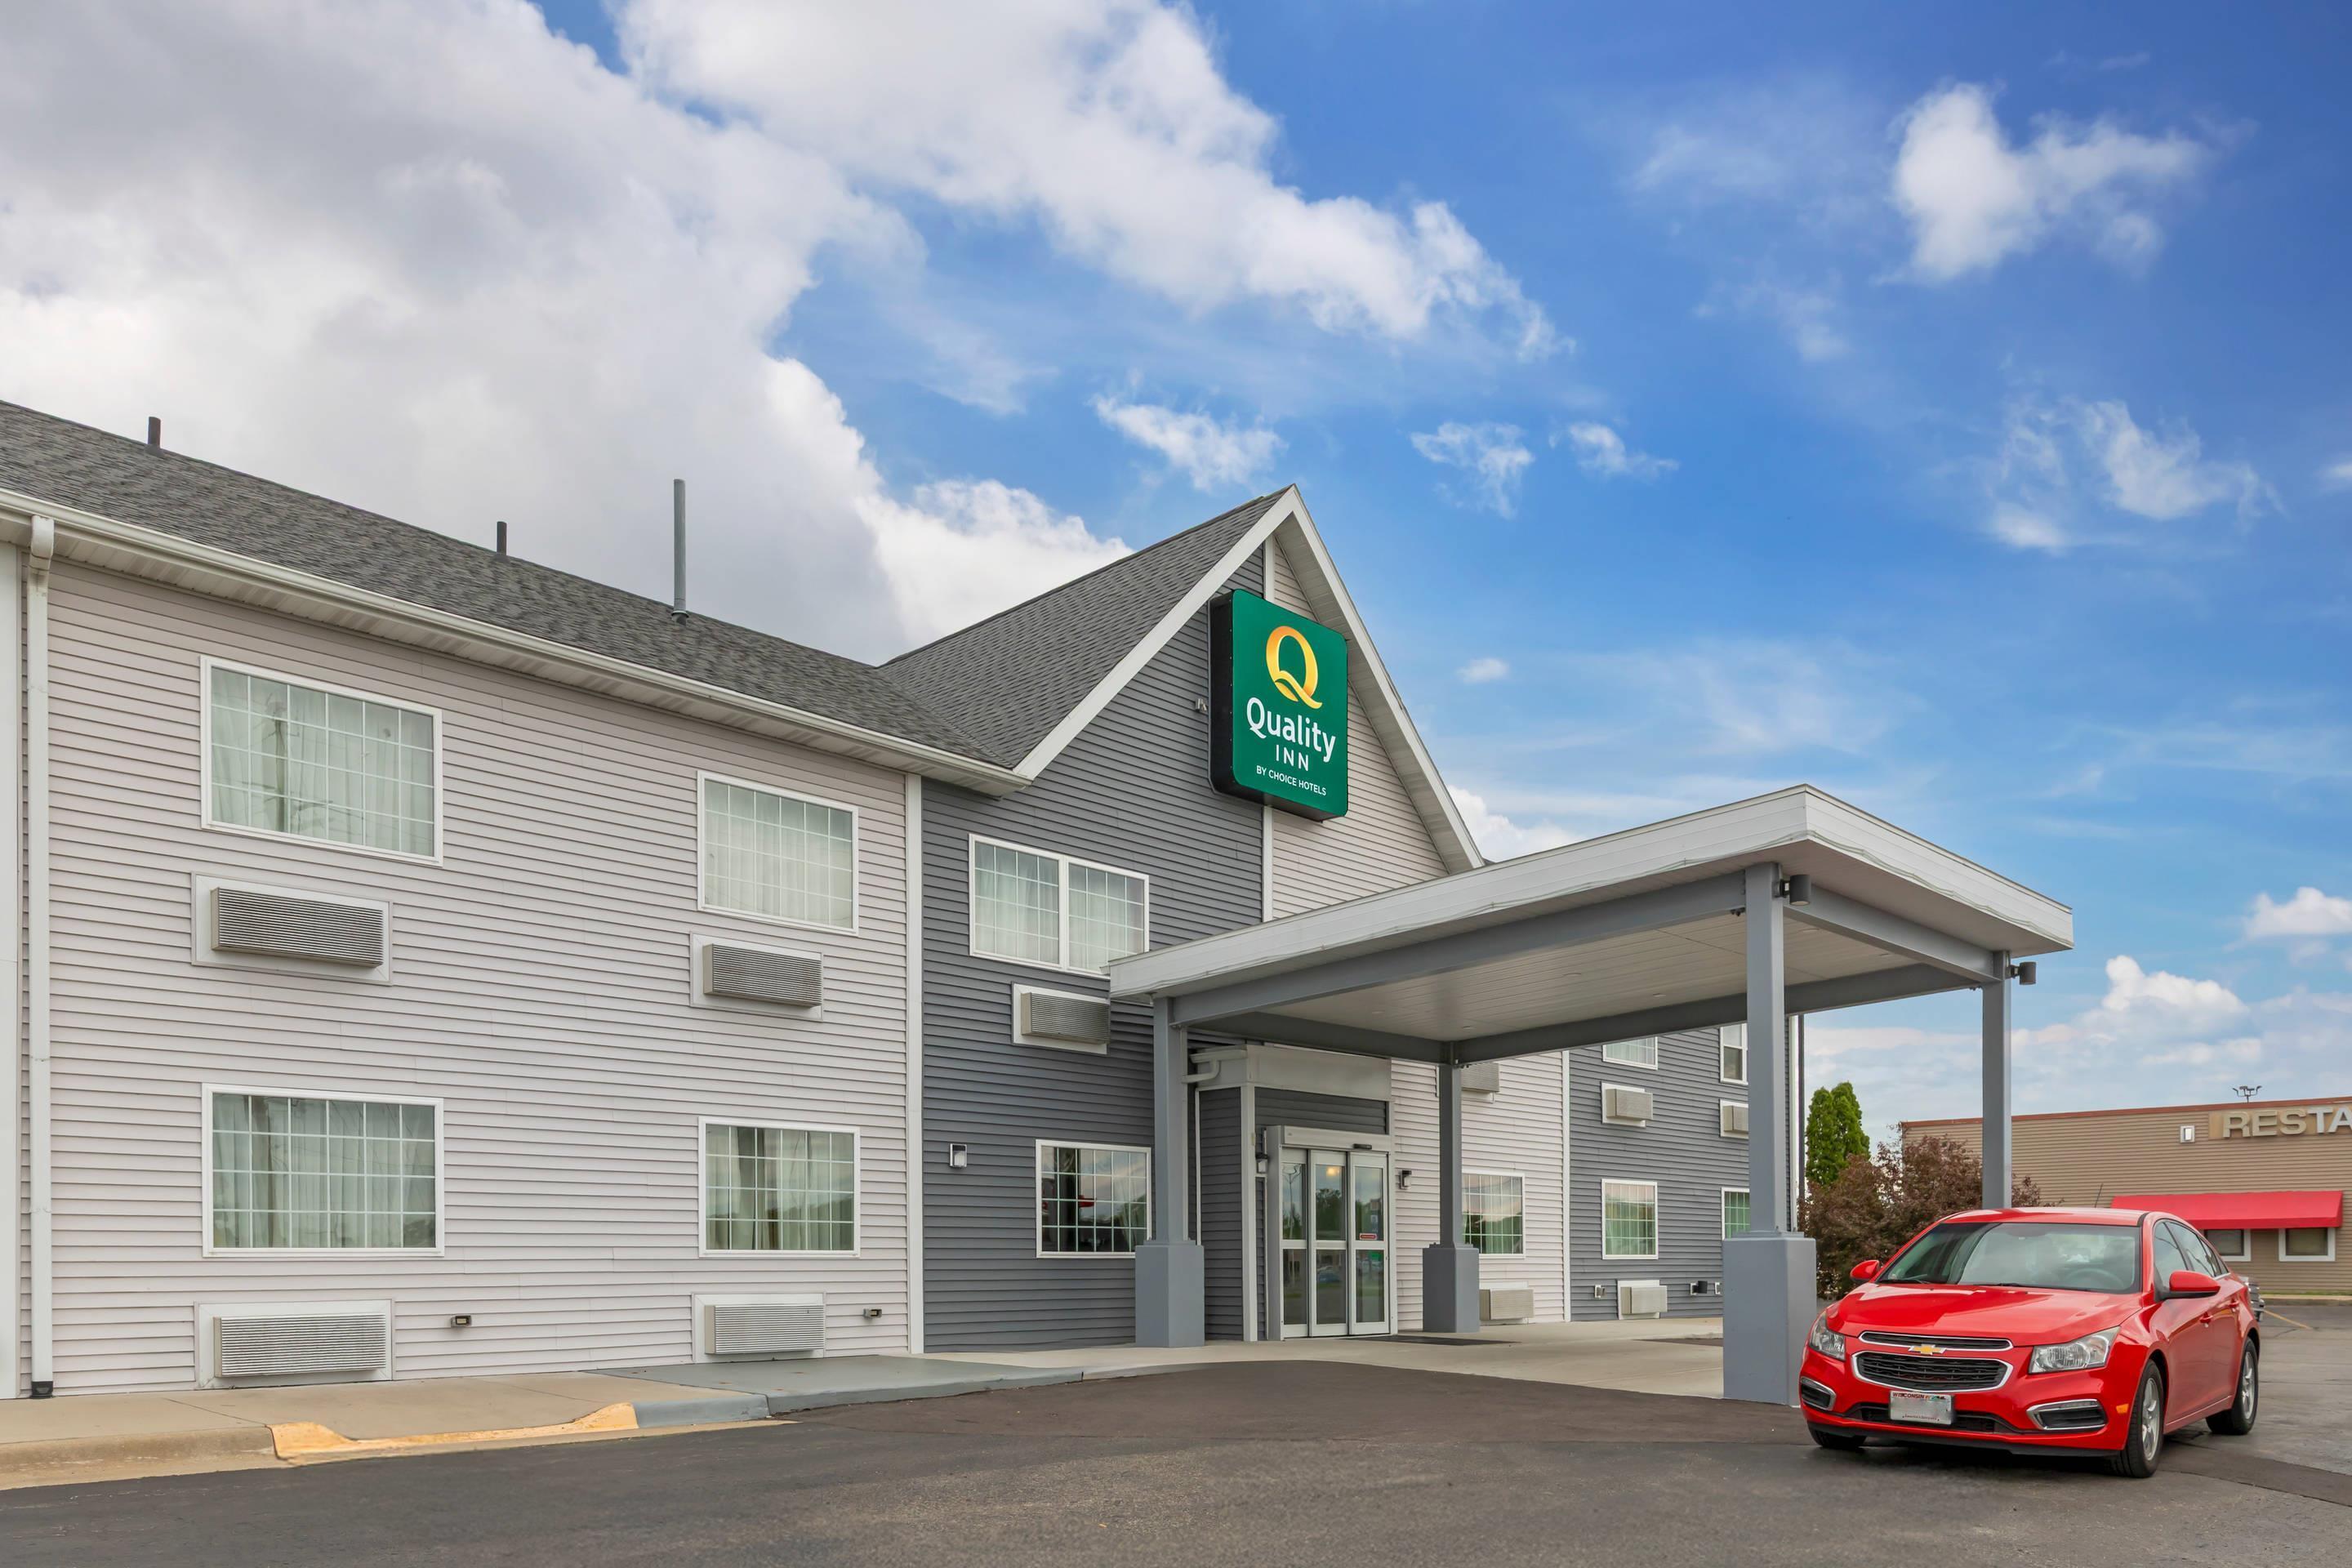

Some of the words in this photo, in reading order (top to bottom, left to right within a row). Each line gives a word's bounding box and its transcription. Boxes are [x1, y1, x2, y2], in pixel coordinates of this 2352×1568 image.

[1266, 626, 1323, 709] Q
[1246, 697, 1336, 762] Quality
[1276, 744, 1308, 771] INN
[1256, 765, 1267, 775] BY
[1268, 770, 1297, 786] CHOICE
[1298, 780, 1326, 796] HOTELS
[2222, 1107, 2352, 1138] RESTA
